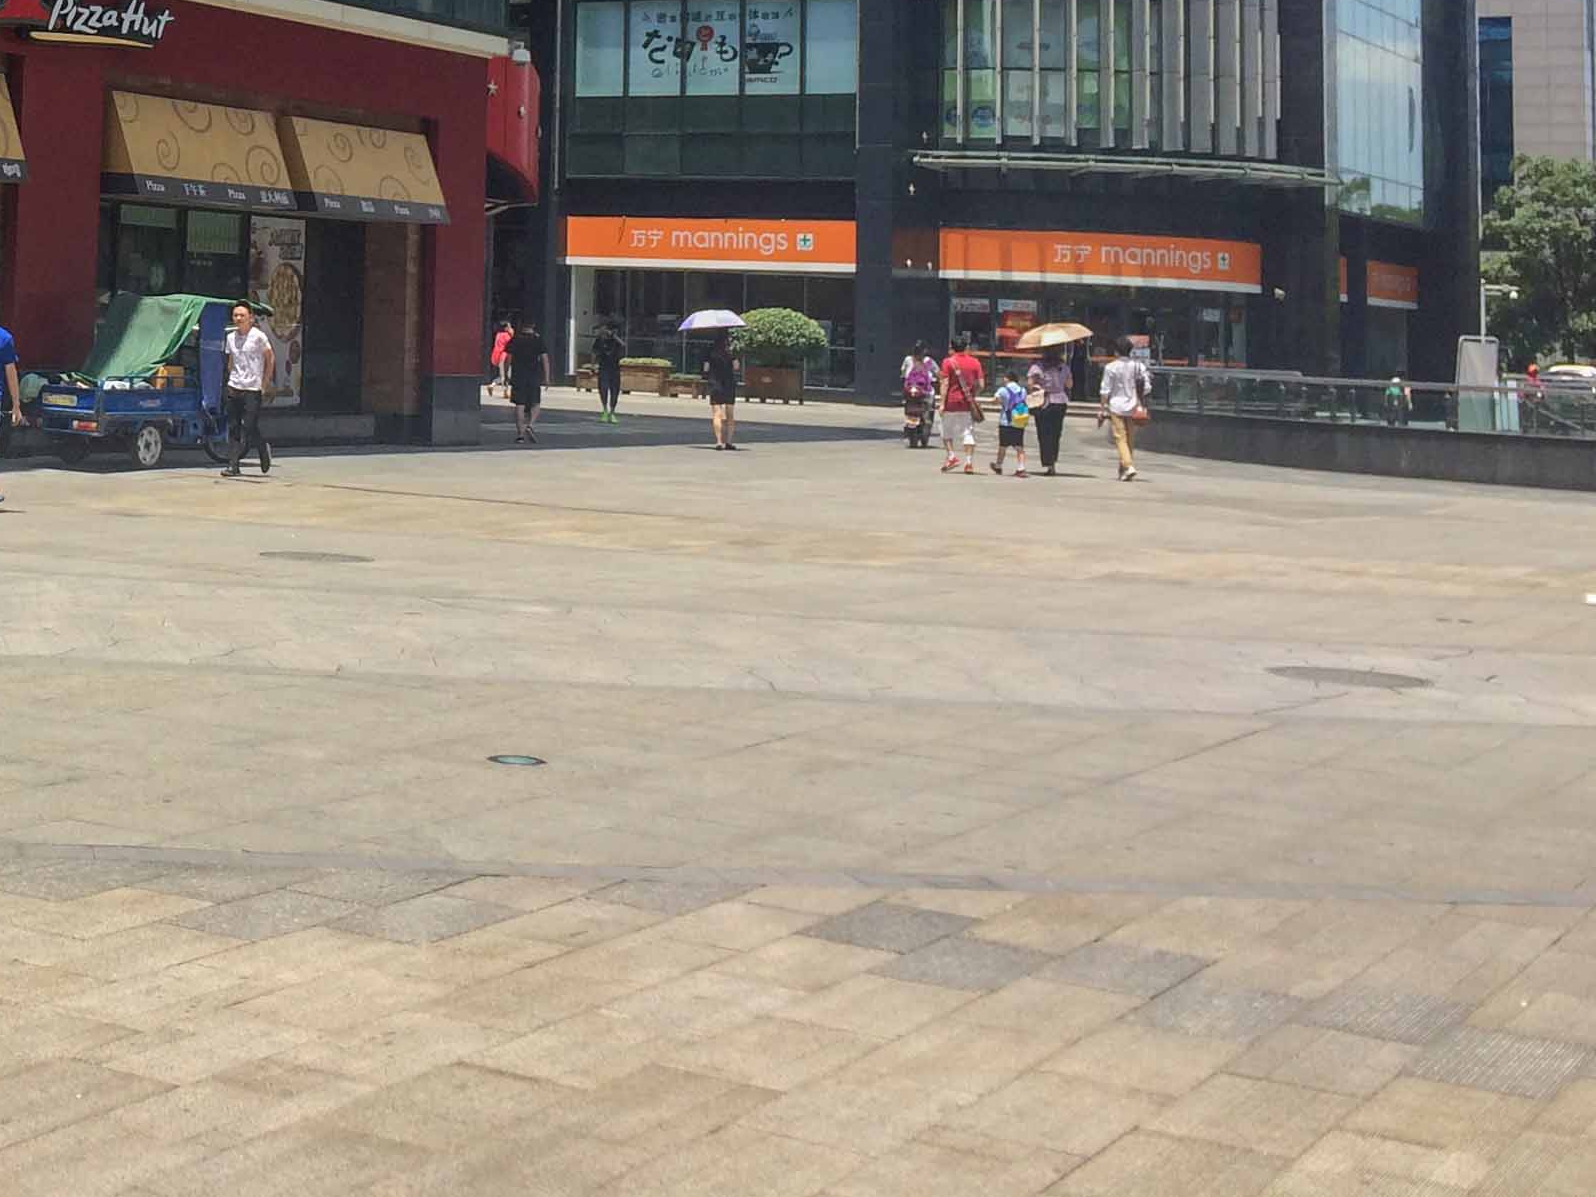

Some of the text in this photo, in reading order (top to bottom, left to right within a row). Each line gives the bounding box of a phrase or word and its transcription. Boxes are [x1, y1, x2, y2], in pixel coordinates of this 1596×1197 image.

[145, 179, 165, 193] Pizza
[228, 188, 246, 201] Pizza
[630, 227, 789, 255] 万宁 mannings
[1053, 243, 1211, 274] 万宁 mannings
